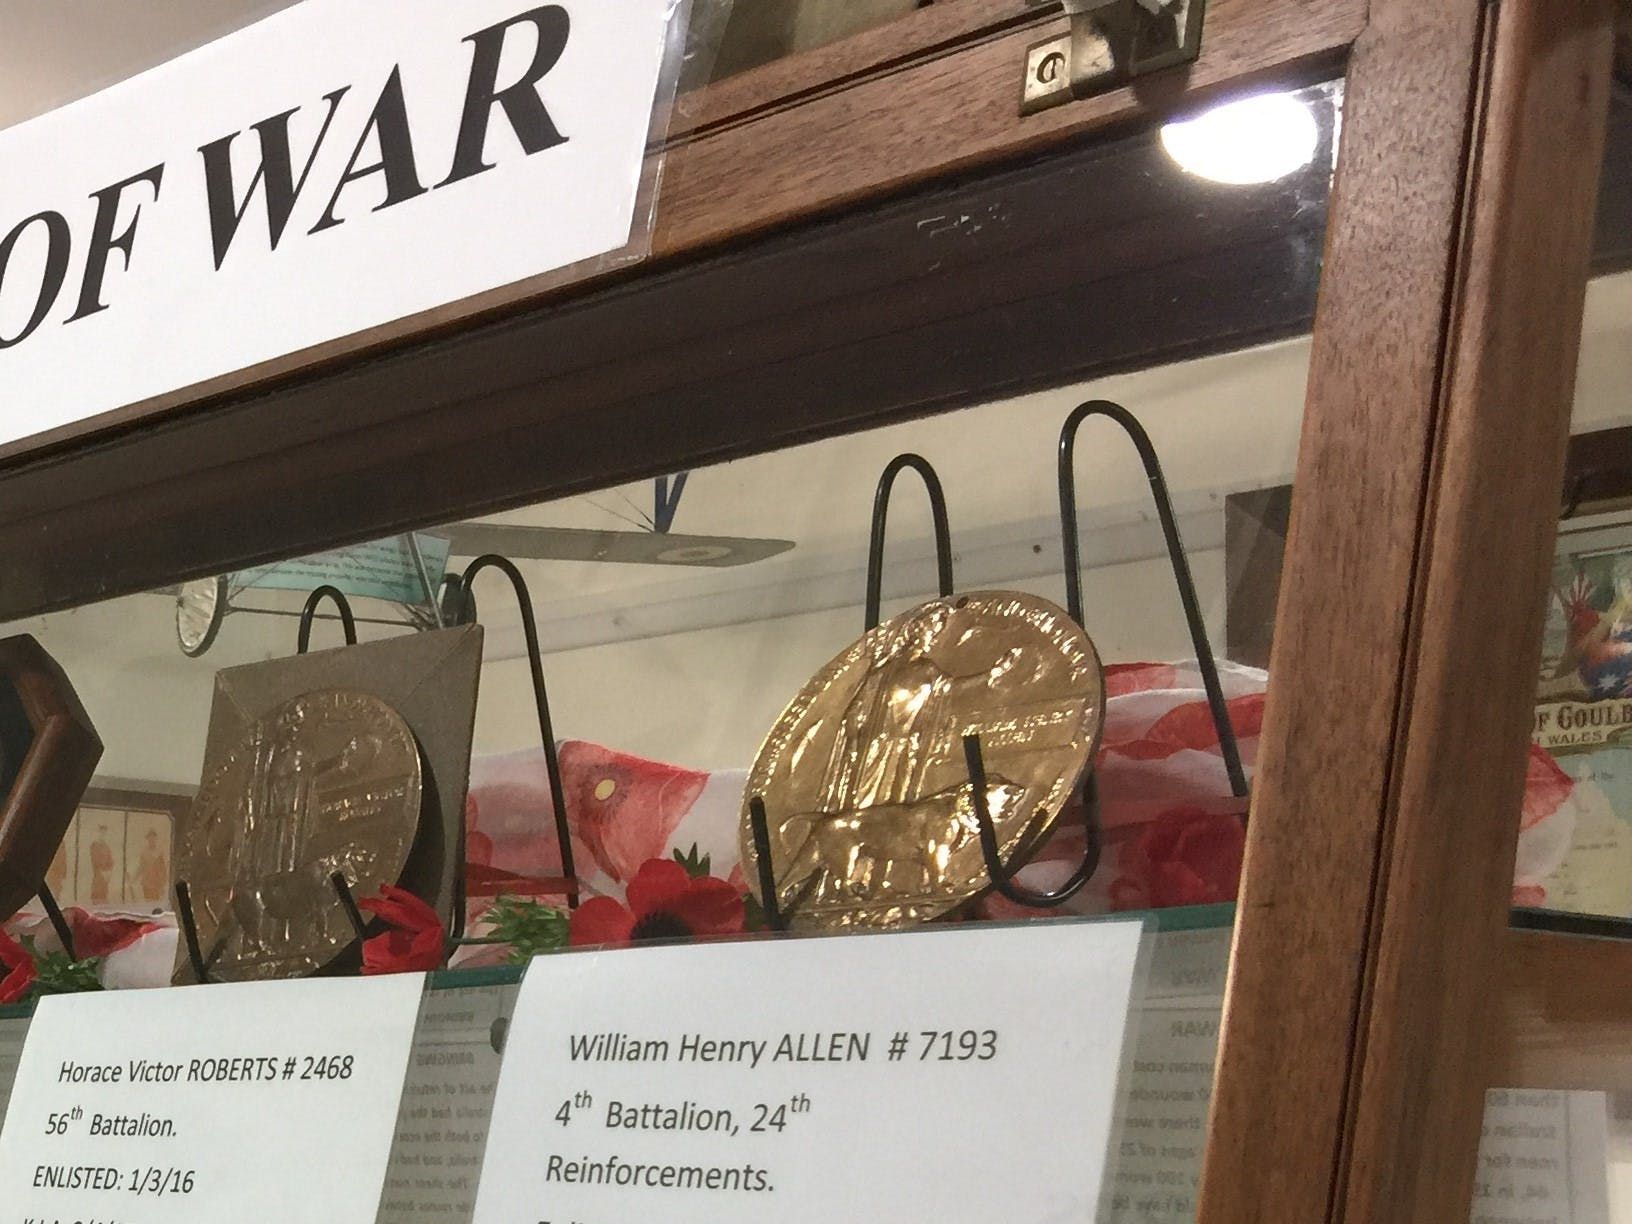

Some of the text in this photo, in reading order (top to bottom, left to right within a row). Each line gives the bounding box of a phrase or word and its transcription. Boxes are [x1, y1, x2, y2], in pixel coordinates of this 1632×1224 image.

[196, 4, 571, 271] WAR
[1548, 730, 1601, 744] WALES
[569, 1030, 998, 1068] William Henry ALLEN # 7193
[58, 1055, 353, 1083] Horace Victor ROBERTS # 2468
[45, 1105, 177, 1137] 56th Battalion.
[605, 1101, 741, 1136] Battalion,
[750, 1093, 811, 1133] 24th
[33, 1166, 194, 1196] ENLISTED: 1/3/16
[546, 1155, 775, 1193] Reinforcements.
